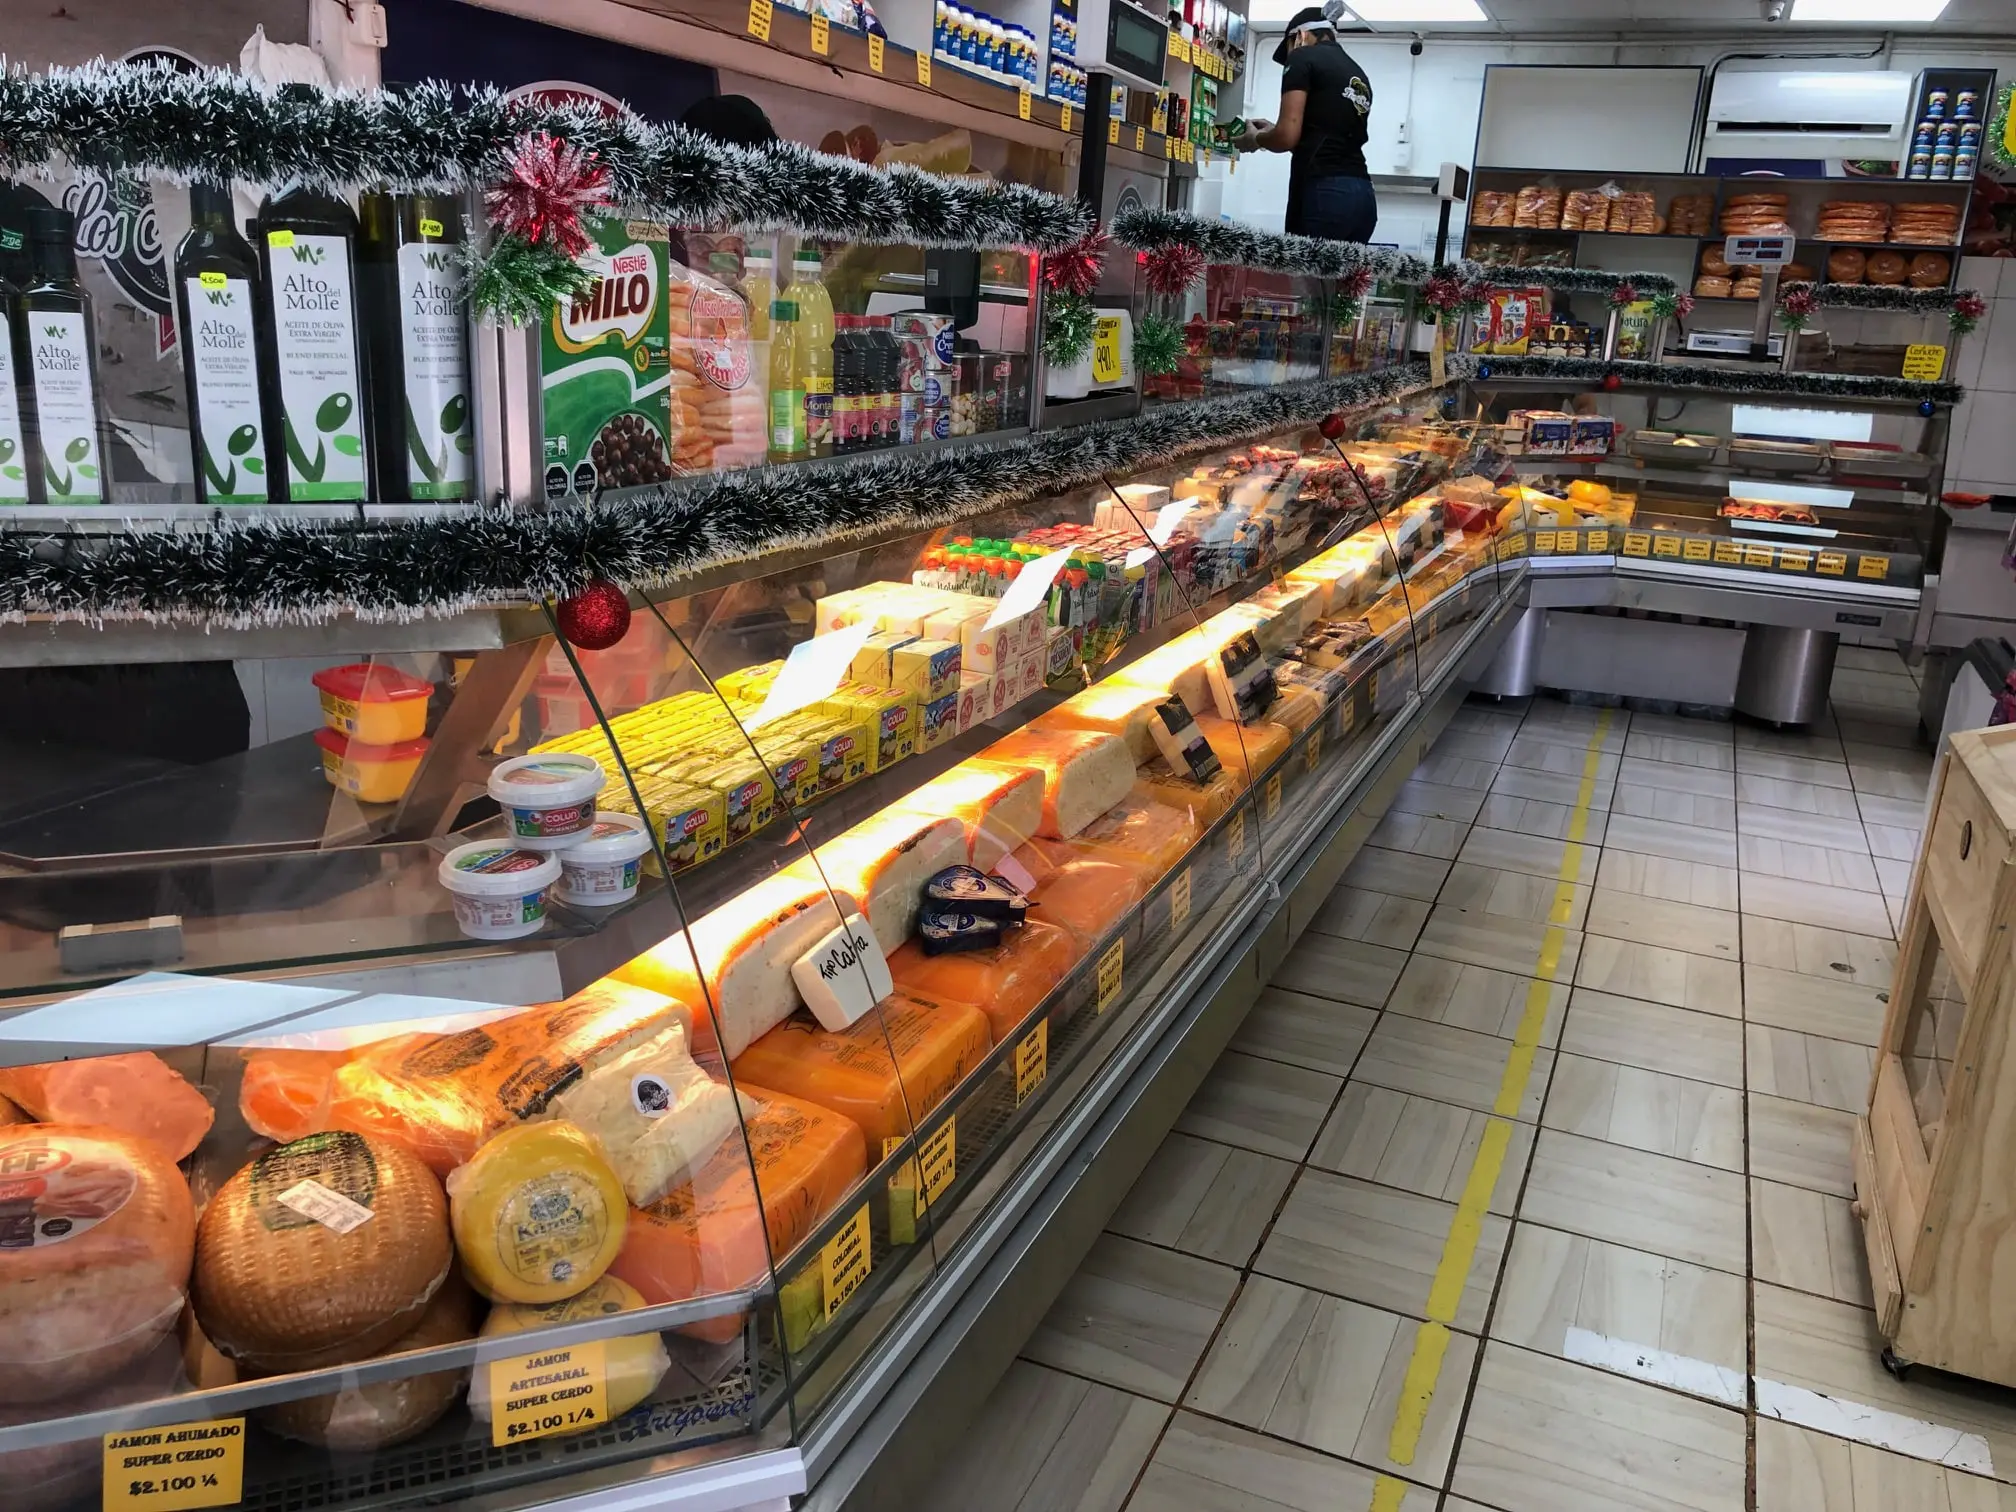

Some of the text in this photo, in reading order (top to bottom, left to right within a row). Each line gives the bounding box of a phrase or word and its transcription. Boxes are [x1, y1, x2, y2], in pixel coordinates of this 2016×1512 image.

[283, 274, 341, 298] Alto del
[412, 280, 452, 299] Alto
[286, 294, 340, 311] Molle
[415, 301, 461, 316] Molle
[570, 273, 650, 326] MILO
[200, 319, 236, 335] Alto
[322, 321, 345, 330] OLIVA
[37, 344, 71, 358] Alto
[202, 335, 246, 349] Molle
[40, 358, 81, 371] Molle
[545, 811, 578, 824] COLUN
[820, 959, 839, 980] Tipo
[942, 1158, 953, 1175] 1/4
[837, 1220, 857, 1248] JAMON
[832, 1234, 861, 1270] COLONIAL
[855, 1265, 867, 1285] 1/4
[525, 1352, 571, 1370] JAMON
[509, 1367, 589, 1392] ARTESANAL
[506, 1384, 594, 1411] SUPER CERDO
[507, 1408, 595, 1438] $2.100 1/4
[108, 1425, 241, 1449] JAMON AHUMADO
[123, 1447, 226, 1468] SUPER CERDO
[128, 1475, 197, 1496] $2.100
